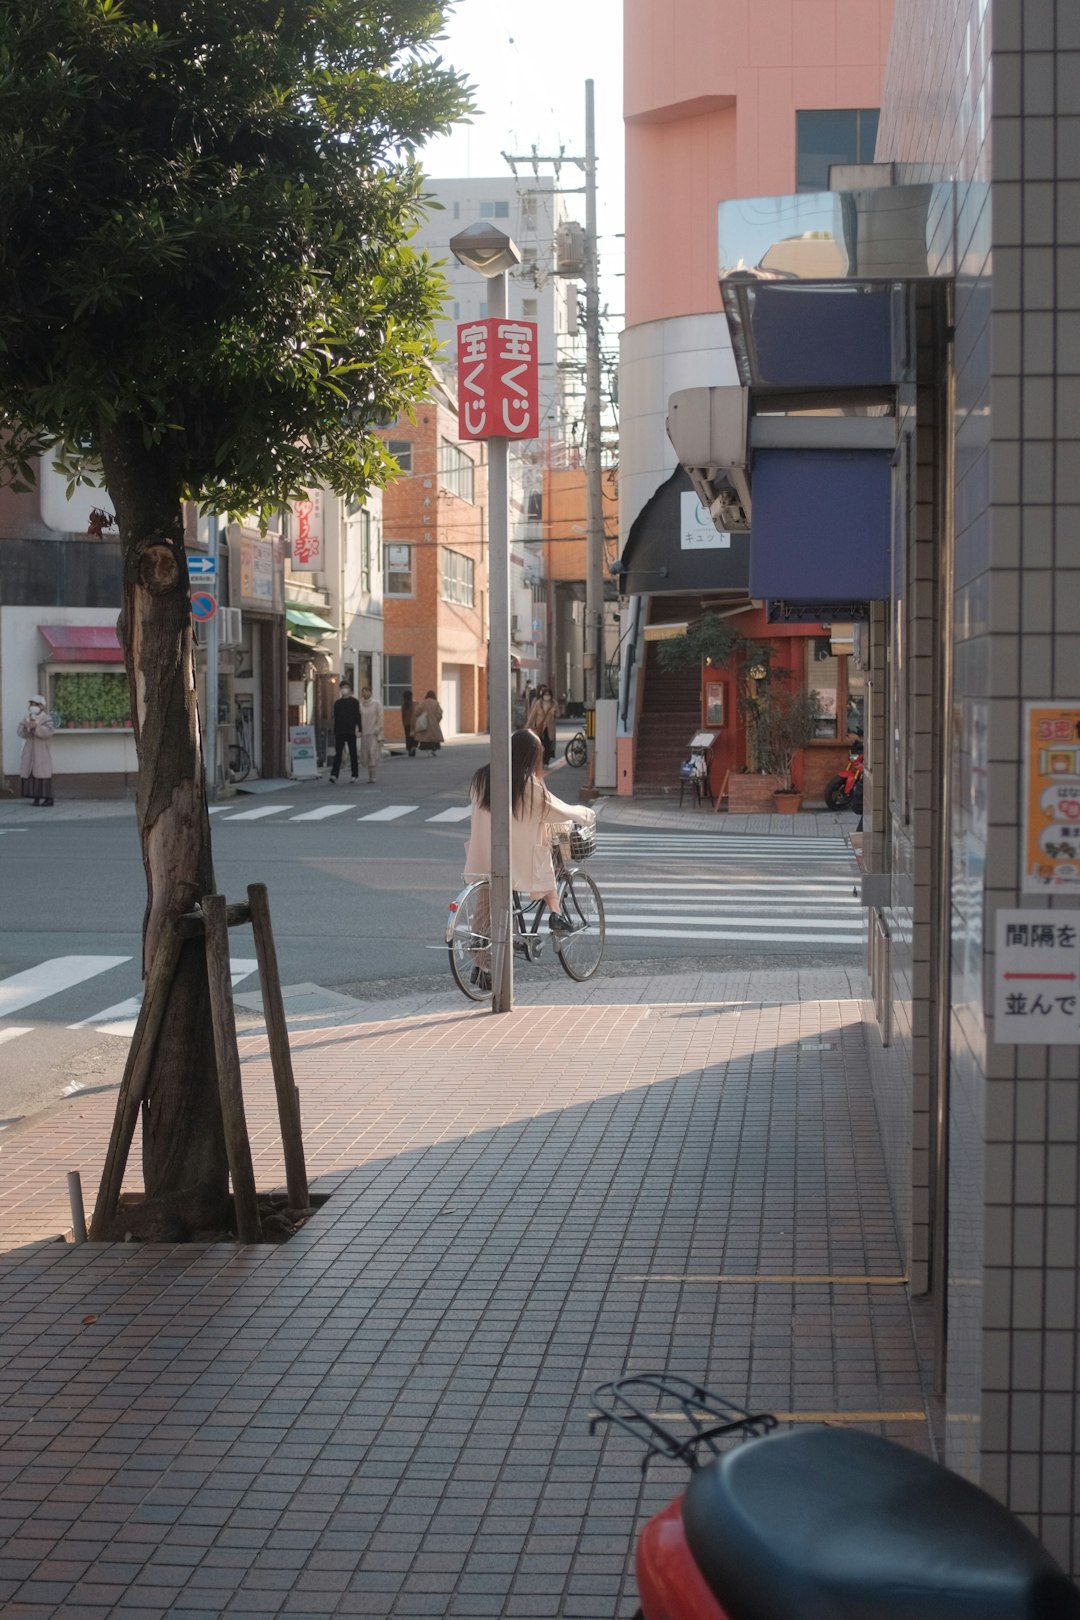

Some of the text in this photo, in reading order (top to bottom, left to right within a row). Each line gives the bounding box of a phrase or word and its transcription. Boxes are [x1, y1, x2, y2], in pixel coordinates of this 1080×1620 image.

[461, 325, 488, 435] 宝くじ
[498, 323, 533, 434] 宝くじ
[685, 532, 725, 544] キュット
[1039, 718, 1080, 741] 3密
[1005, 923, 1077, 948] 間隔を
[1004, 993, 1077, 1016] 並んで
